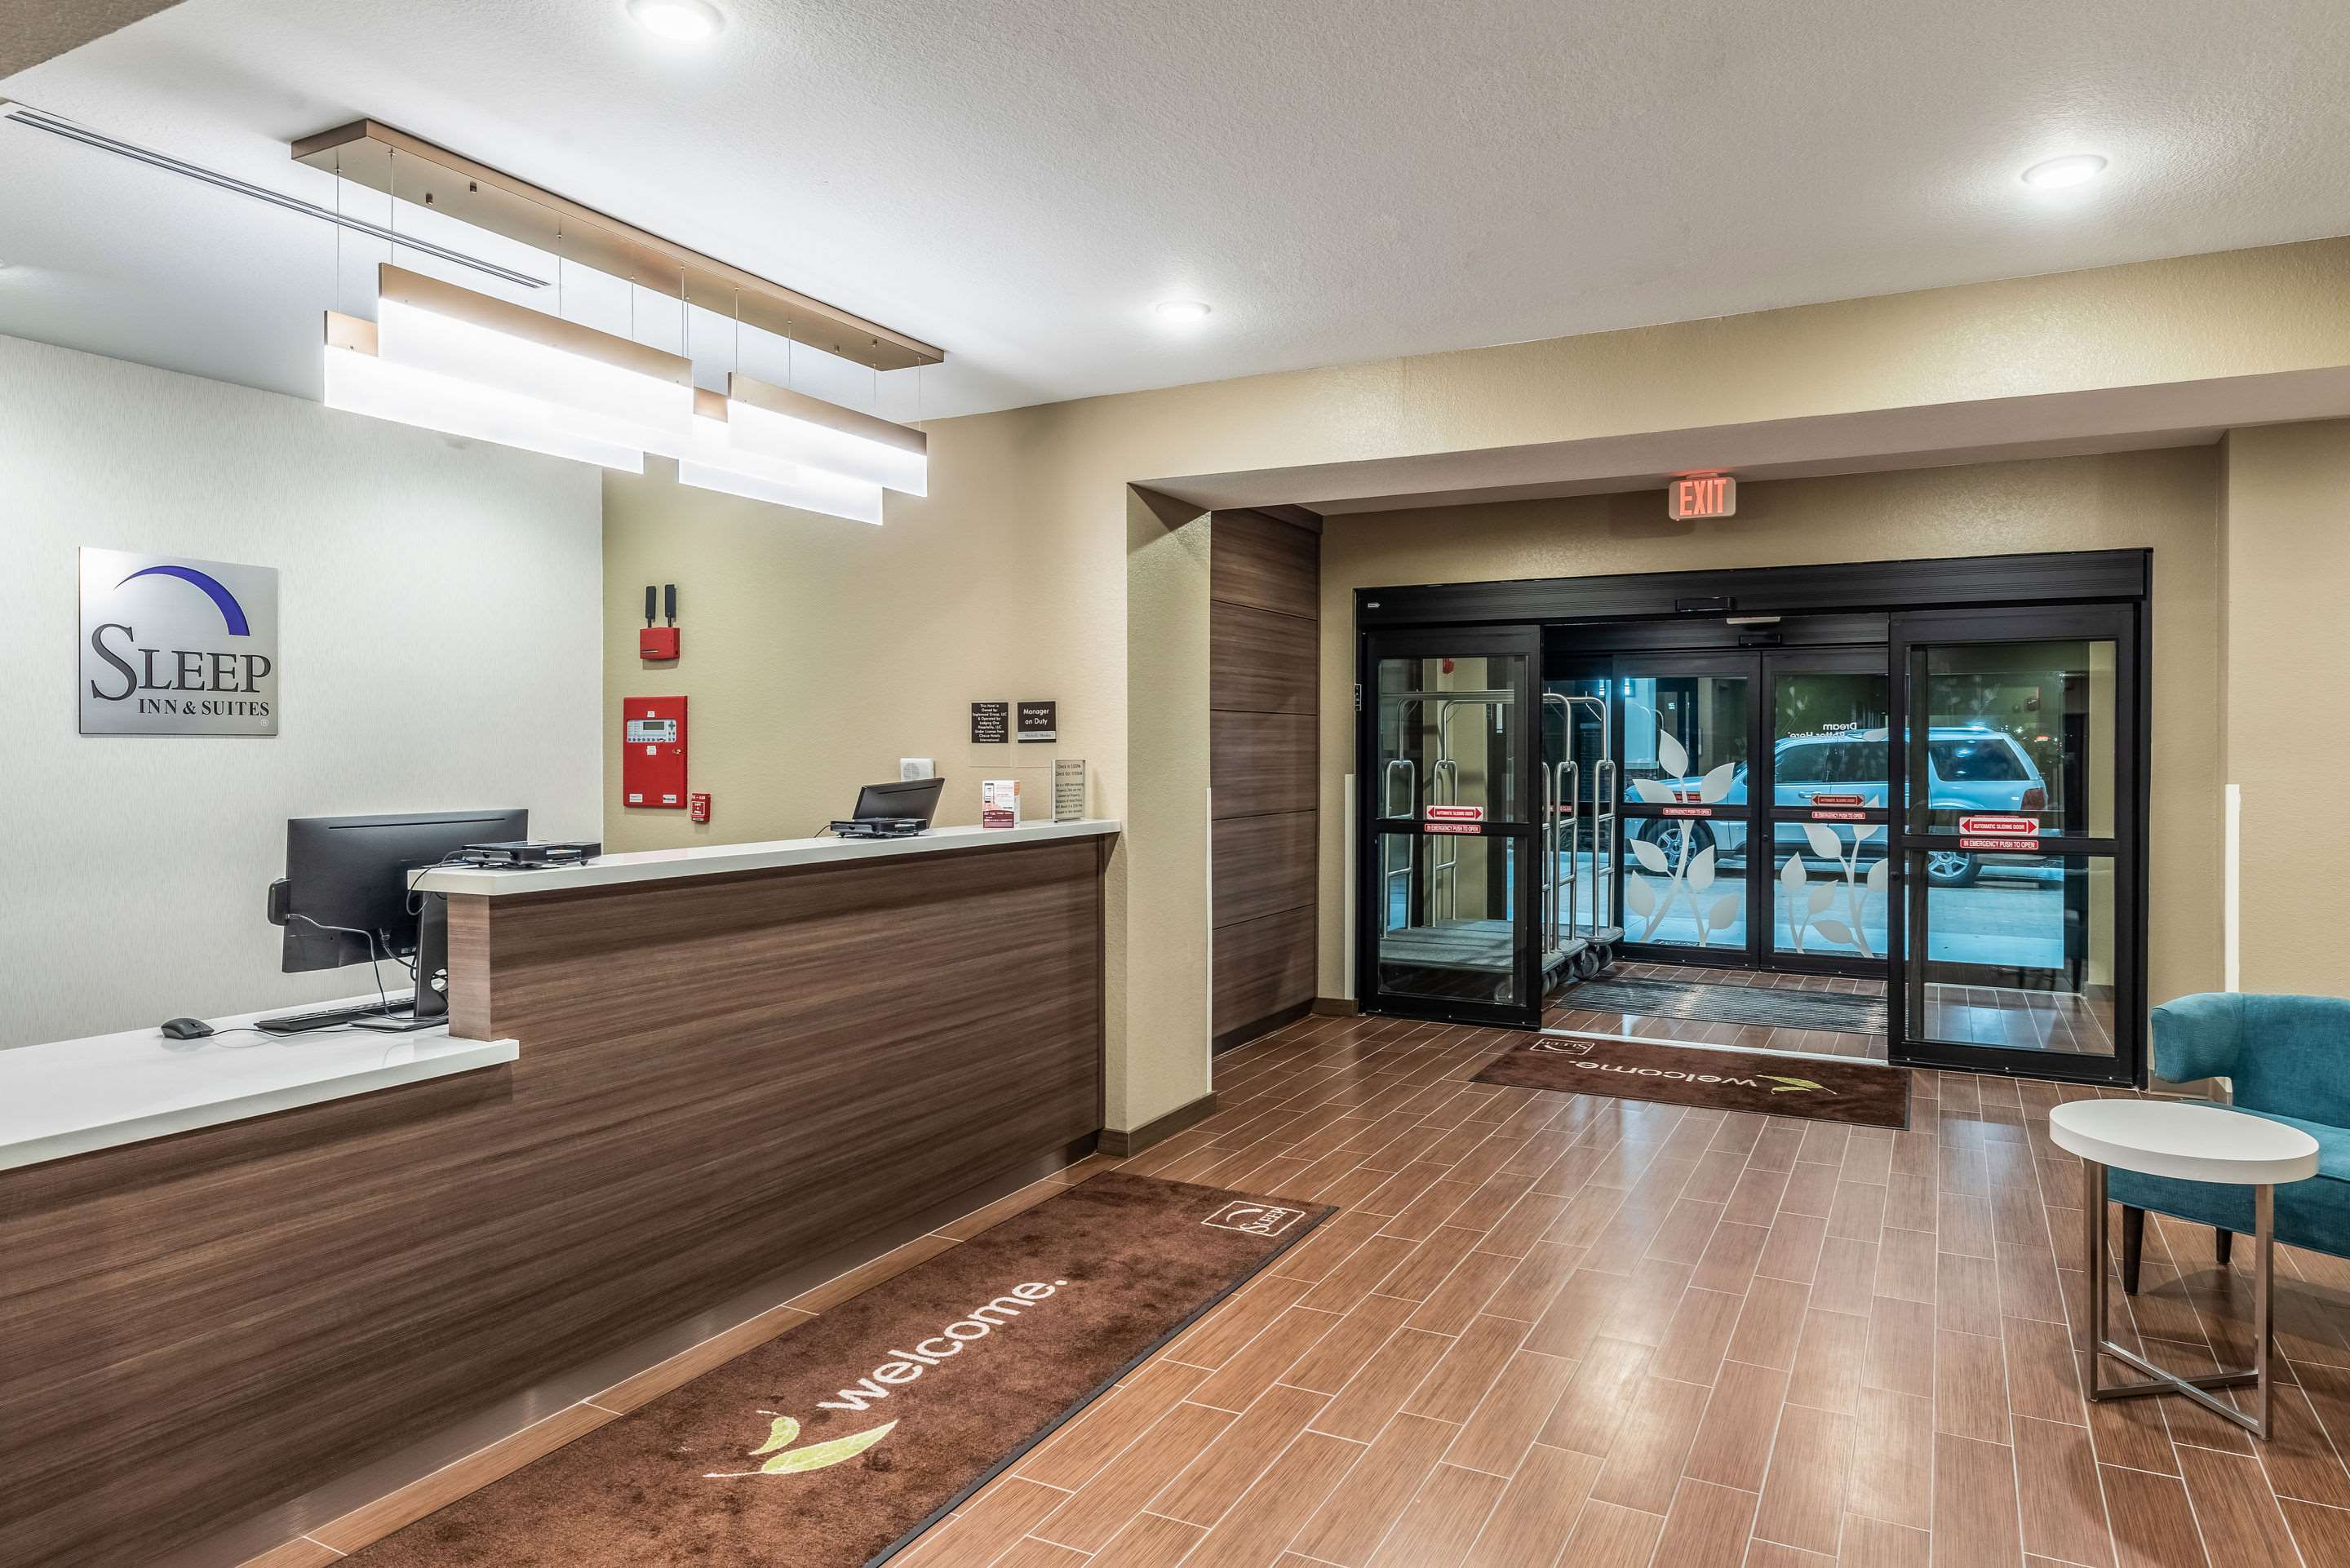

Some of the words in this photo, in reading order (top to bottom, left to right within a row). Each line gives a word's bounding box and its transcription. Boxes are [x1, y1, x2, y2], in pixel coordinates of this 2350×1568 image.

[1680, 479, 1726, 516] EXIT
[91, 623, 271, 701] SLEEP
[137, 698, 177, 714] INN
[183, 701, 196, 715] &
[202, 700, 269, 716] SUITES
[1023, 708, 1049, 716] Manager
[1034, 717, 1048, 725] Duty
[1569, 1061, 1758, 1087] welcome.
[1240, 1207, 1288, 1233] SLEEP
[816, 1279, 1068, 1411] welcome.
